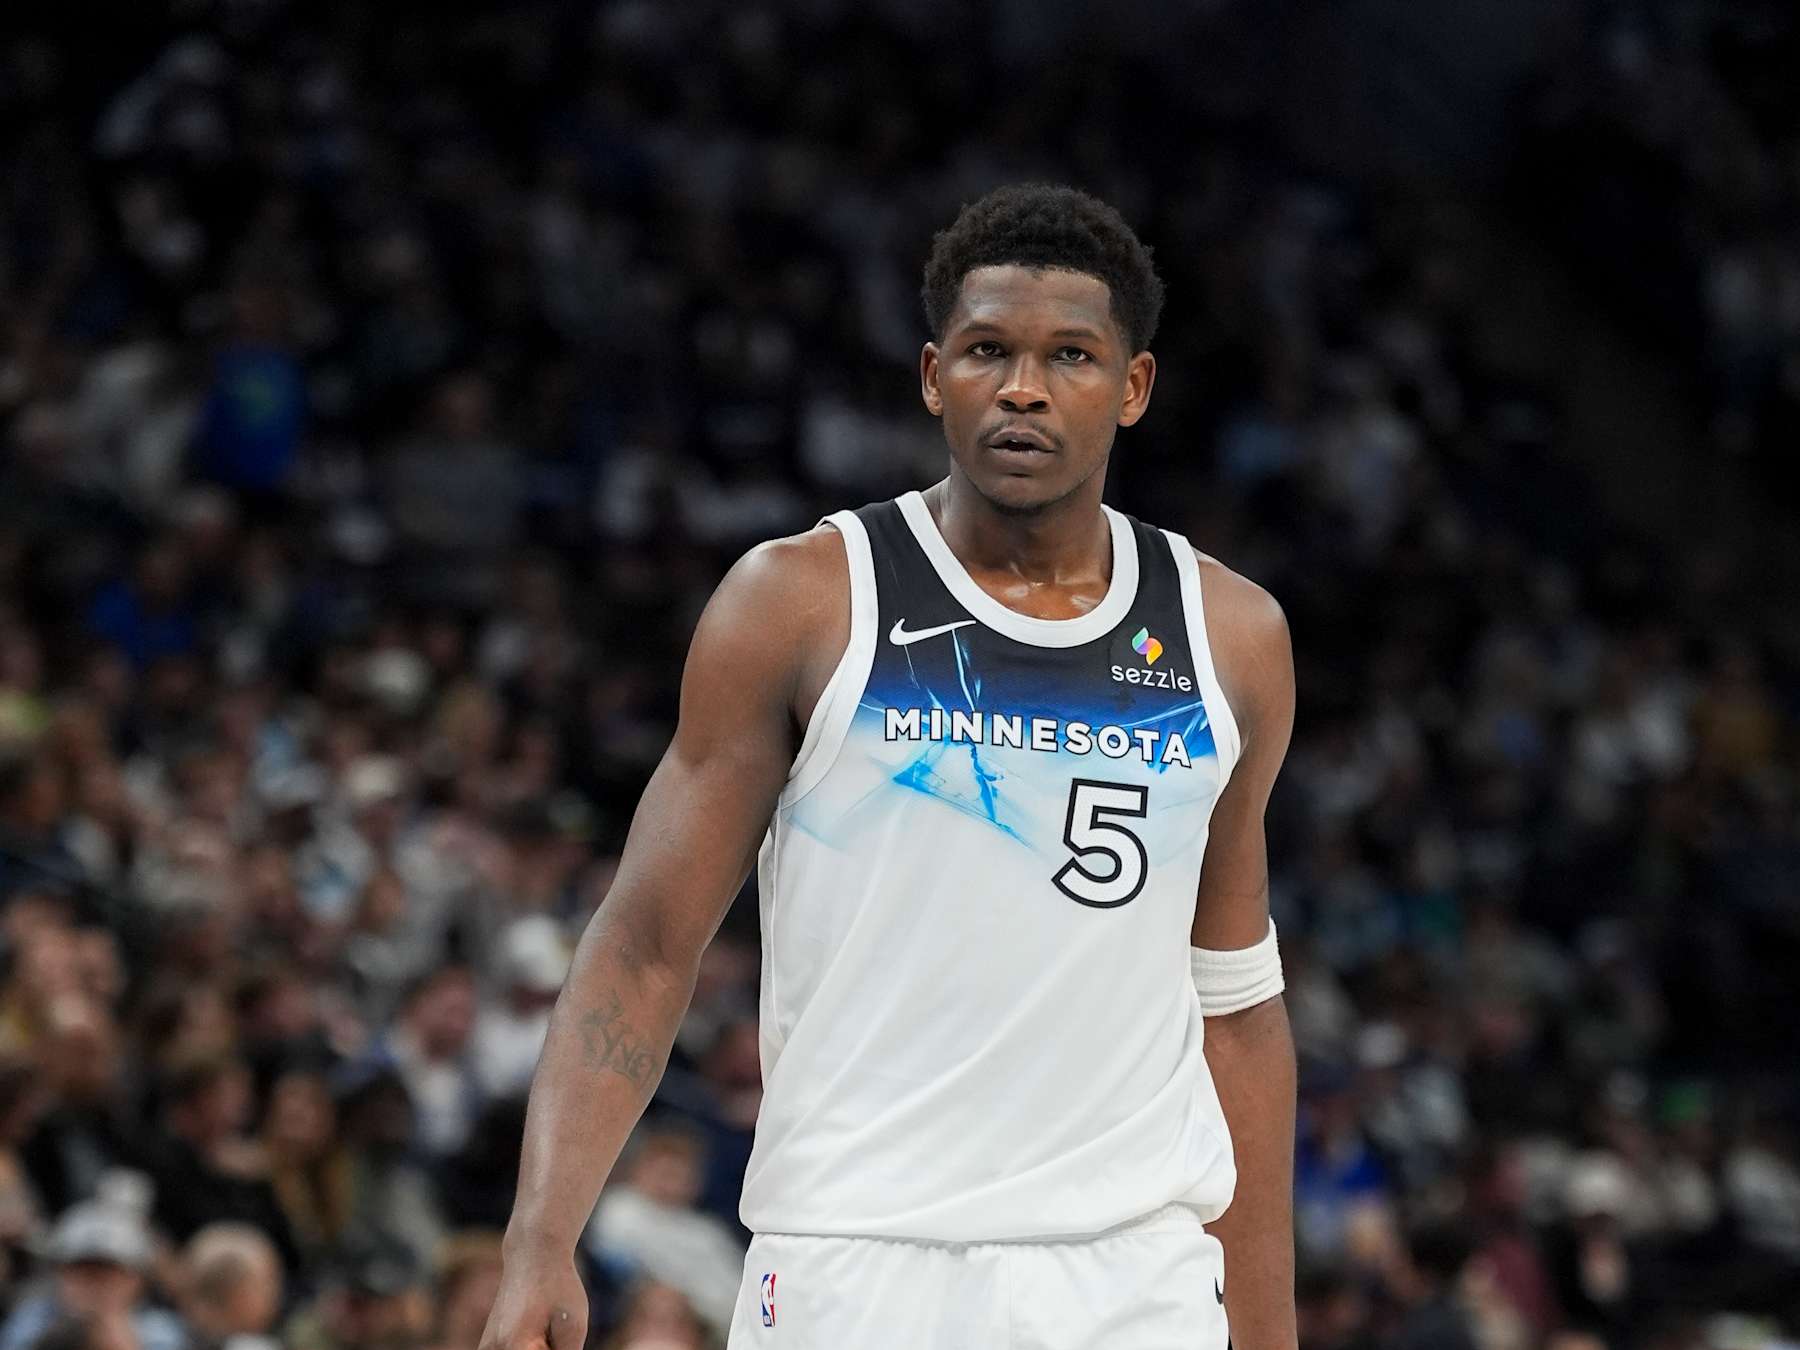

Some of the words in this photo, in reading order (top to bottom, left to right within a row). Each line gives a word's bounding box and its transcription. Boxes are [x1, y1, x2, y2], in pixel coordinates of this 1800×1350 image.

[1111, 665, 1192, 692] sezzle
[884, 708, 1192, 769] MINNESOTA
[1052, 778, 1149, 909] 5
